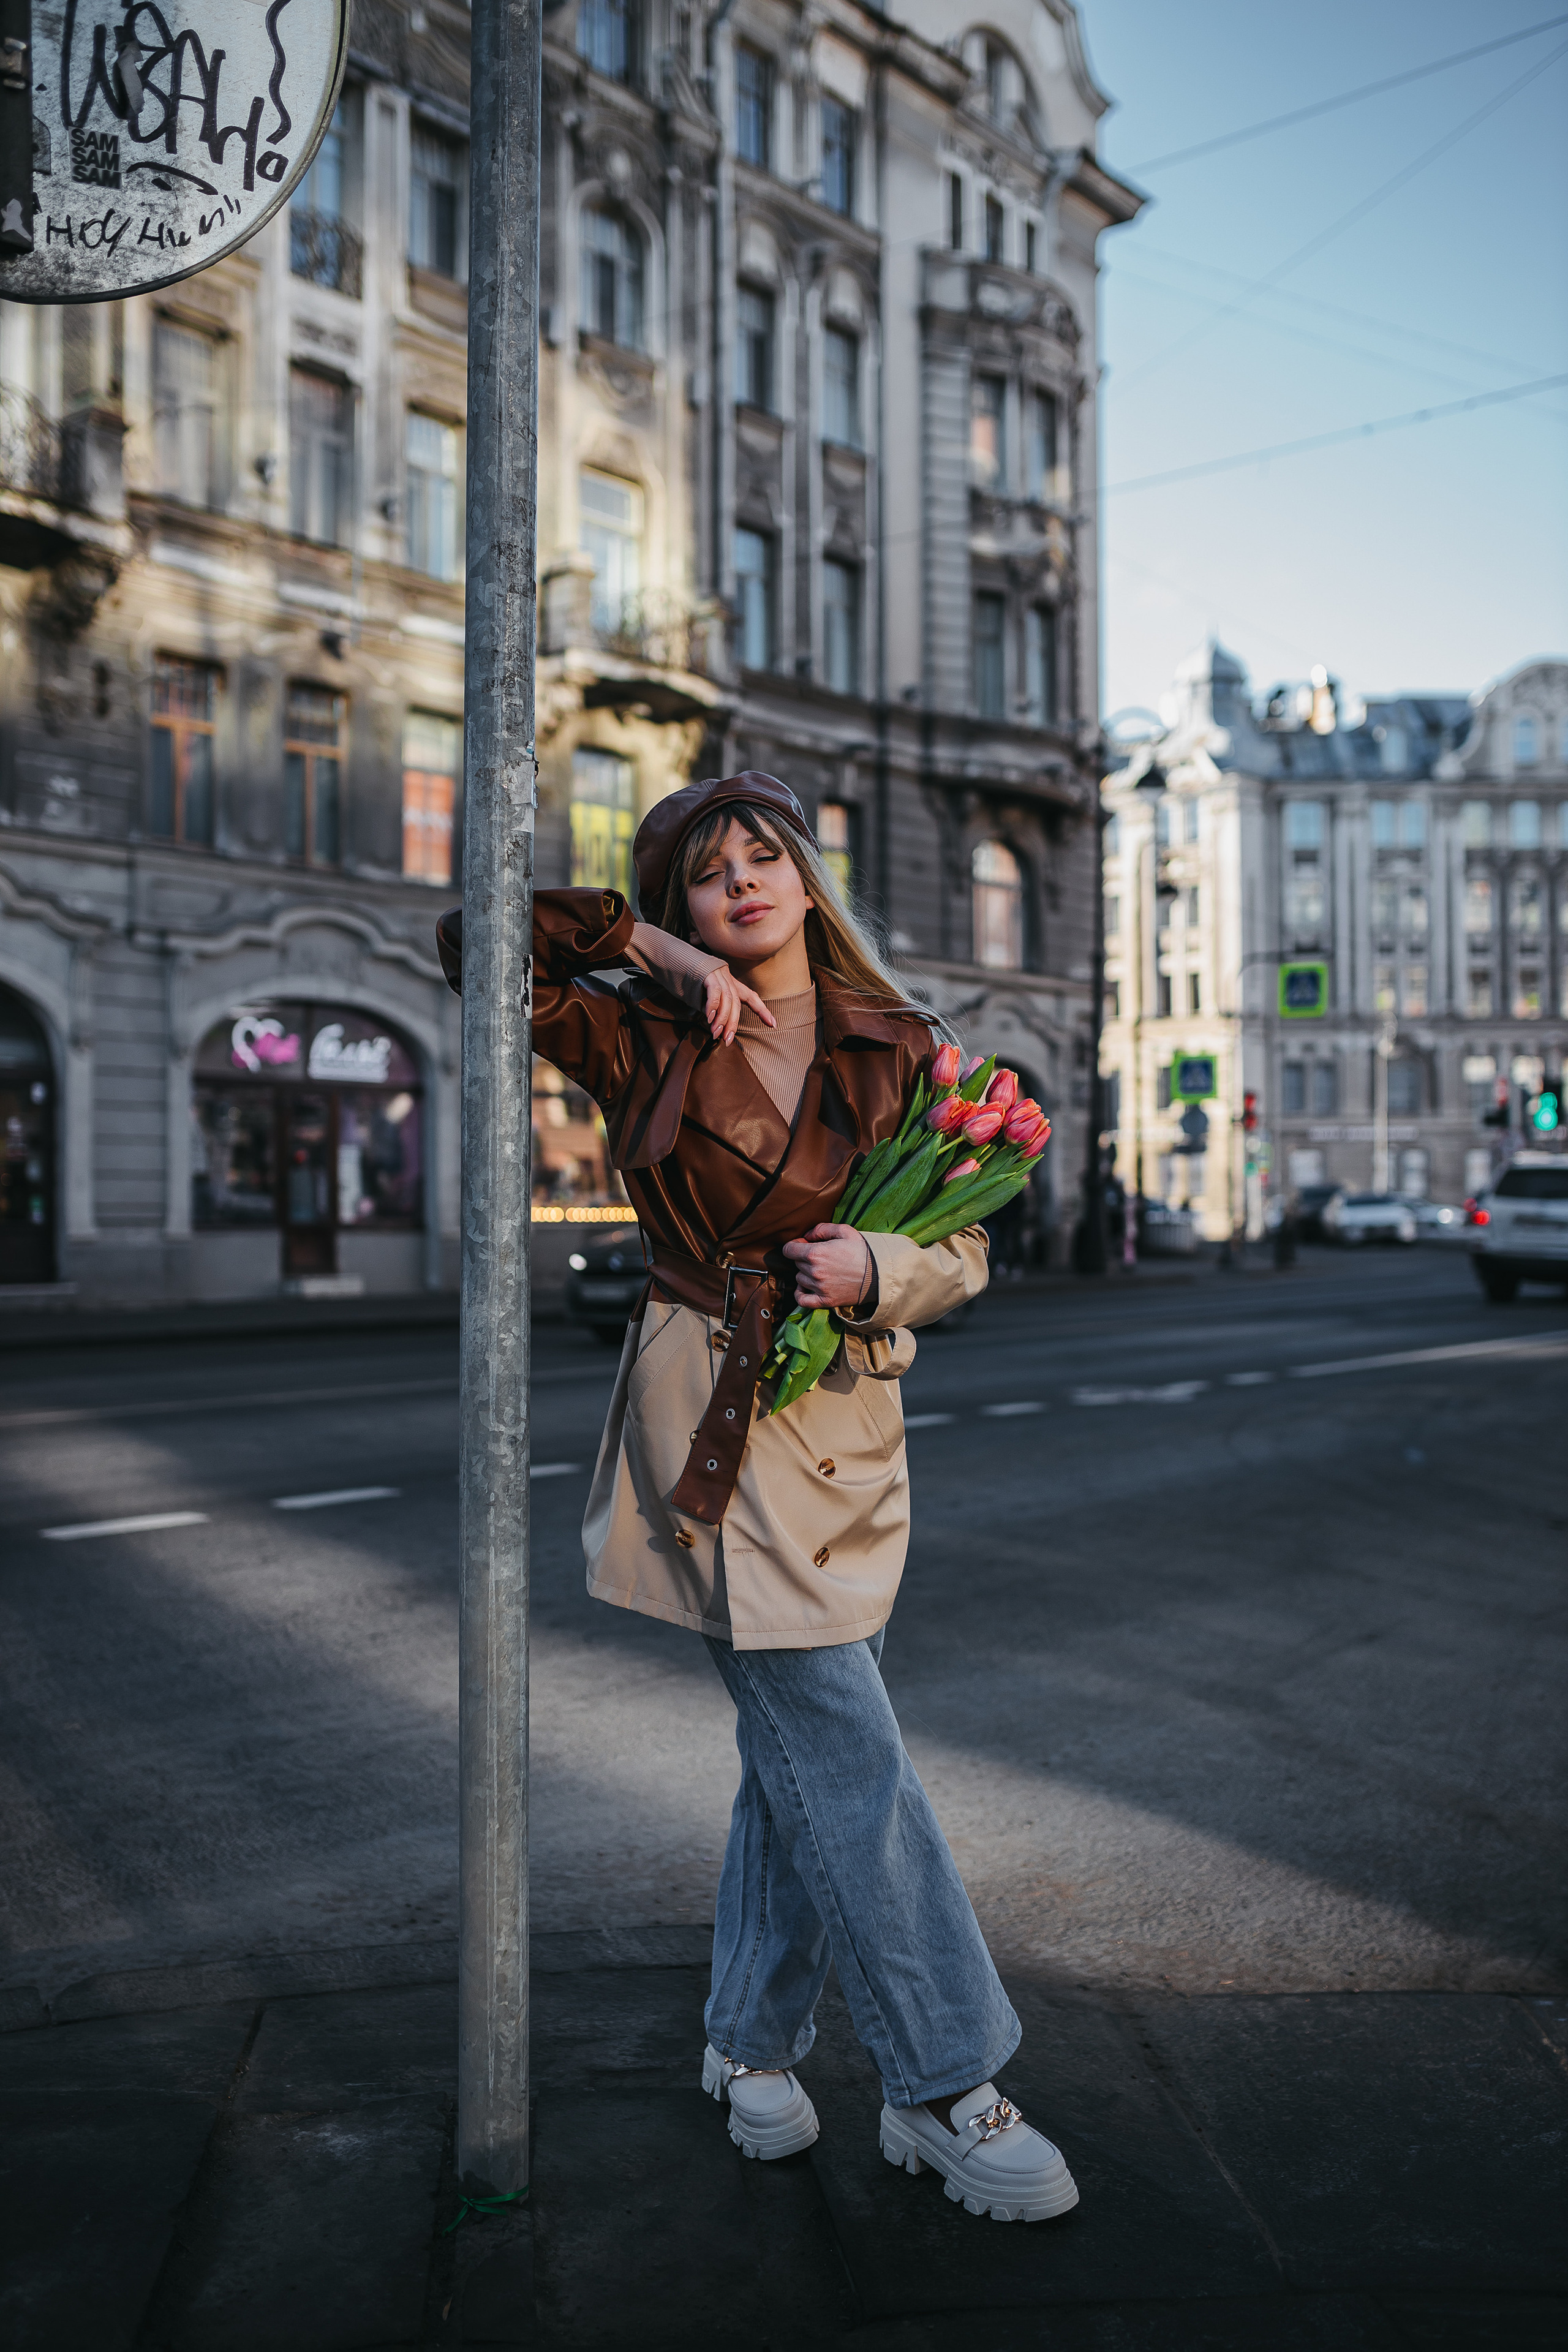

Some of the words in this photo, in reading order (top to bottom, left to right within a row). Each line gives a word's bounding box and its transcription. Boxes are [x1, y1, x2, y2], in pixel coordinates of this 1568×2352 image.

[70, 129, 119, 153] SAM
[72, 147, 120, 172] SAM
[72, 165, 122, 189] SAM
